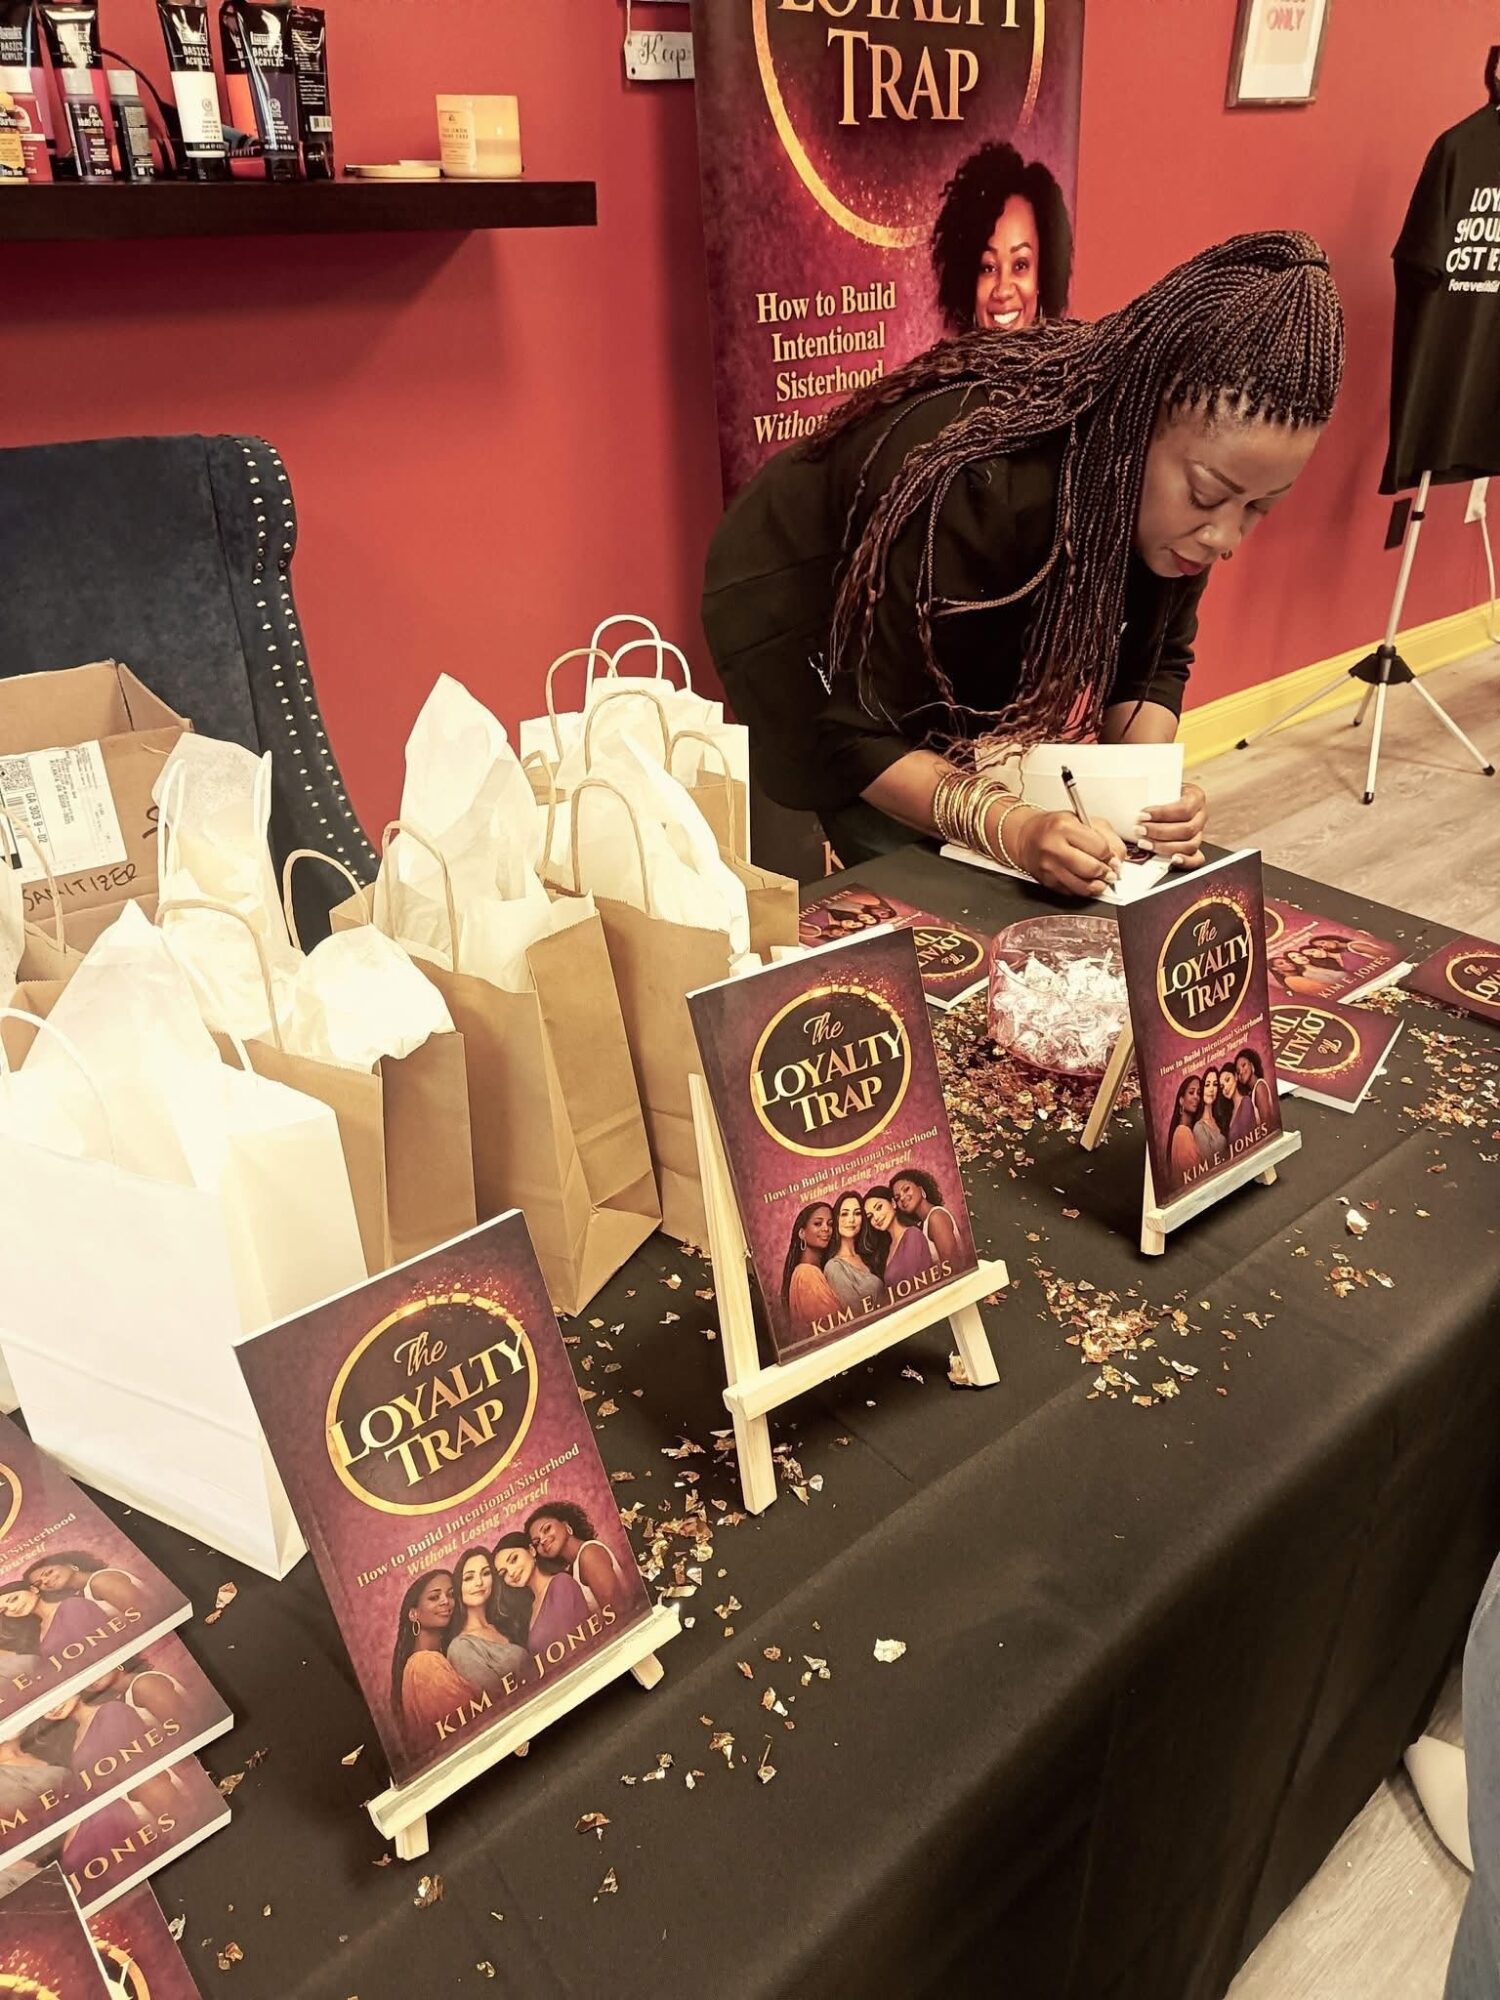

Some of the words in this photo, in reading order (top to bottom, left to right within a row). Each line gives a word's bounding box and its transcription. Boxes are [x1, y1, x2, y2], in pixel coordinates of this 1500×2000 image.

[182, 45, 210, 58] BASICS
[827, 27, 980, 125] TRAP
[756, 292, 810, 324] How
[816, 290, 835, 318] to
[841, 281, 897, 314] Build
[771, 321, 885, 362] Intentional
[776, 359, 884, 402] Sisterhood
[1193, 919, 1217, 946] The
[1160, 931, 1250, 997] LOYALTY
[1181, 972, 1236, 1018] TRAP
[1318, 981, 1345, 999] KIM
[1355, 955, 1391, 980] JONES
[803, 1012, 844, 1046] The
[1160, 1064, 1175, 1077] How
[1175, 1060, 1183, 1069] to
[1184, 1049, 1201, 1065] Build
[1201, 1032, 1234, 1056] Intentional
[1234, 1013, 1264, 1036] Sisterhood
[1182, 1057, 1206, 1075] Without
[1226, 1033, 1248, 1053] Yourself
[1275, 1010, 1334, 1071] LOYALTY
[1318, 1038, 1342, 1054] The
[752, 1027, 904, 1107] LOYALTY
[790, 1076, 882, 1133] TRAP
[763, 1189, 788, 1204] How
[788, 1182, 799, 1194] to
[802, 1169, 829, 1189] Build
[831, 1151, 885, 1177] Intentional
[885, 1125, 938, 1153] Sisterhood
[799, 1182, 839, 1203] Without
[841, 1168, 873, 1187] Losing
[874, 1150, 912, 1173] Yourself
[1182, 1161, 1209, 1185] KIM
[1213, 1152, 1225, 1166] E.
[1229, 1122, 1268, 1158] JONES
[811, 1305, 855, 1337] KIM
[862, 1295, 881, 1314] E.
[887, 1260, 952, 1307] JONES
[393, 1331, 447, 1376] The
[328, 1330, 526, 1467] LOYALTY
[384, 1399, 504, 1487] TRAP
[8, 1512, 77, 1556] Sisterhood
[356, 1563, 390, 1588] How
[390, 1554, 405, 1568] to
[406, 1527, 443, 1558] Build
[445, 1486, 515, 1536] Intentional
[516, 1443, 580, 1490] Sisterhood
[406, 1539, 458, 1577] Without
[461, 1514, 501, 1545] Losing
[503, 1479, 549, 1520] Yourself
[12, 1672, 43, 1691] E.
[49, 1606, 142, 1672] JONES
[435, 1689, 493, 1741] KIM
[501, 1672, 526, 1696] E.
[534, 1603, 616, 1678] JONES
[39, 1789, 70, 1811] E.
[79, 1718, 181, 1792] JONES
[68, 1813, 176, 1897] JONES
